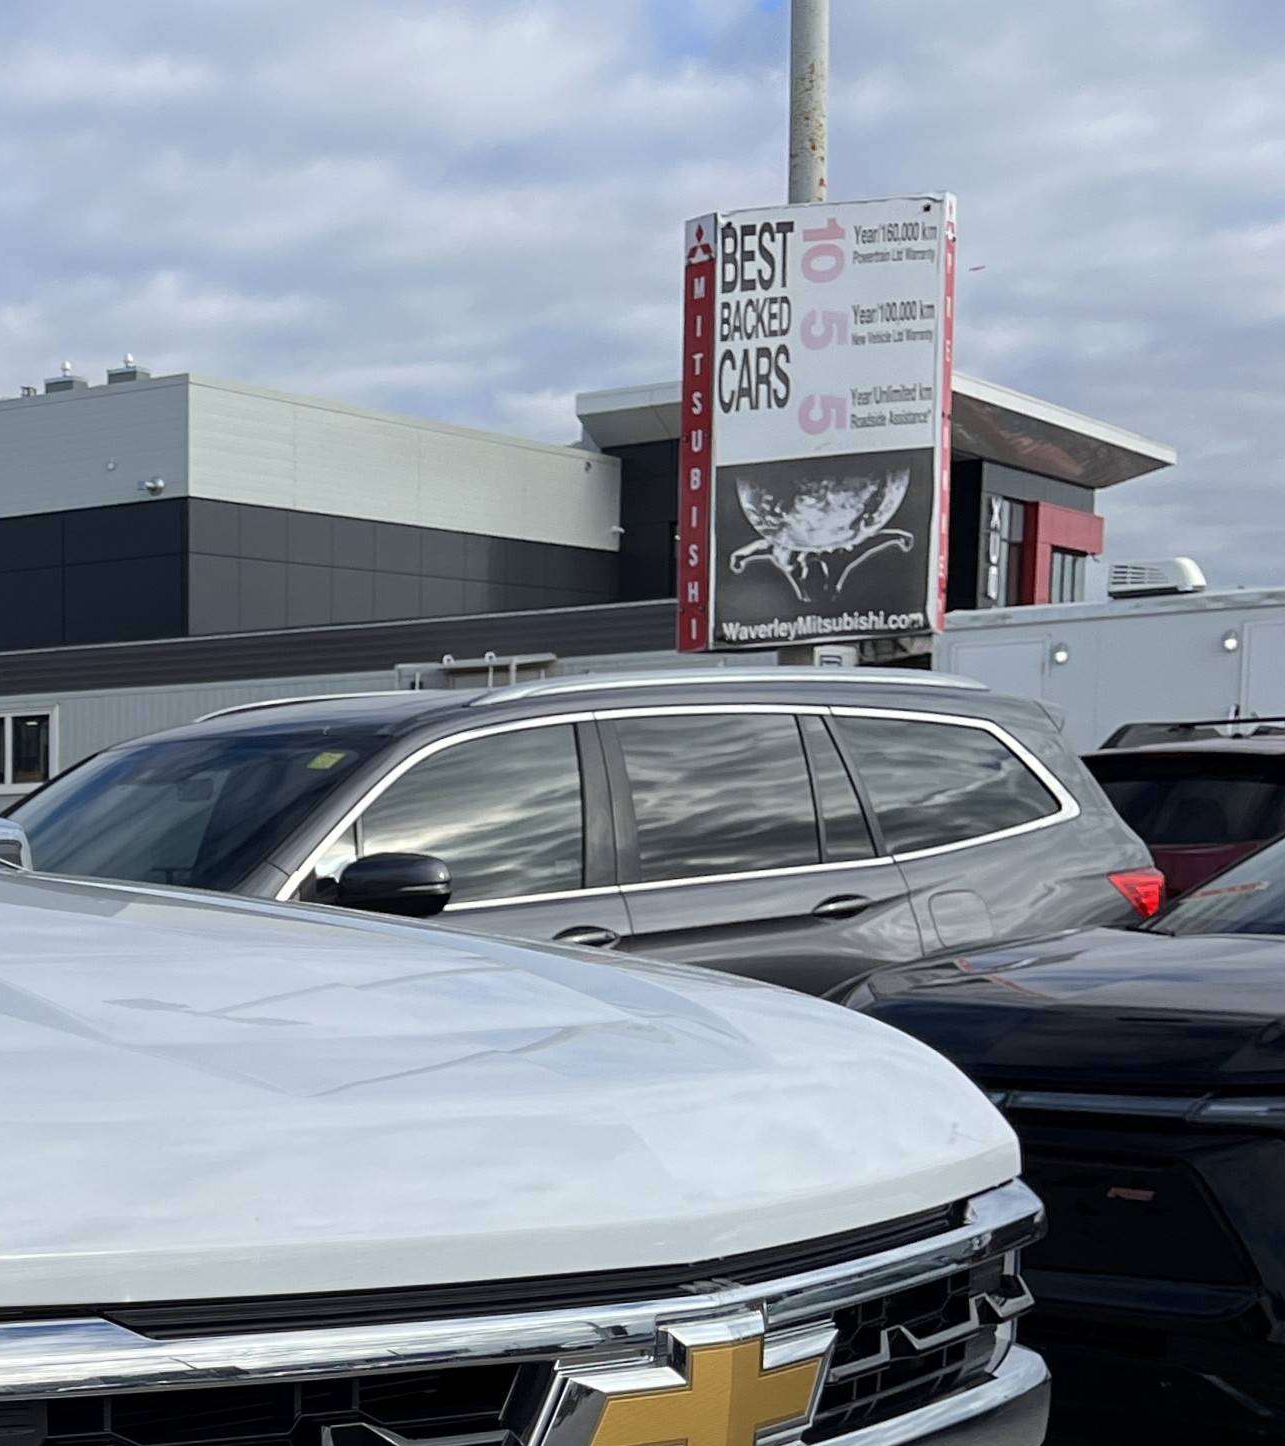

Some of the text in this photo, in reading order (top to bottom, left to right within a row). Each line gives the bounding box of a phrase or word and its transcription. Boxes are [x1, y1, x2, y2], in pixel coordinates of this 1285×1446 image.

[801, 218, 846, 283] 10
[921, 221, 937, 242] km
[721, 221, 794, 293] BEST
[720, 296, 791, 341] BACKED
[800, 309, 848, 350] 5
[919, 300, 935, 320] km
[718, 344, 790, 413] CARS
[798, 394, 847, 435] 5
[687, 276, 706, 640] MITSUBISHI
[722, 611, 924, 641] WaverleyMitsubishi.com
